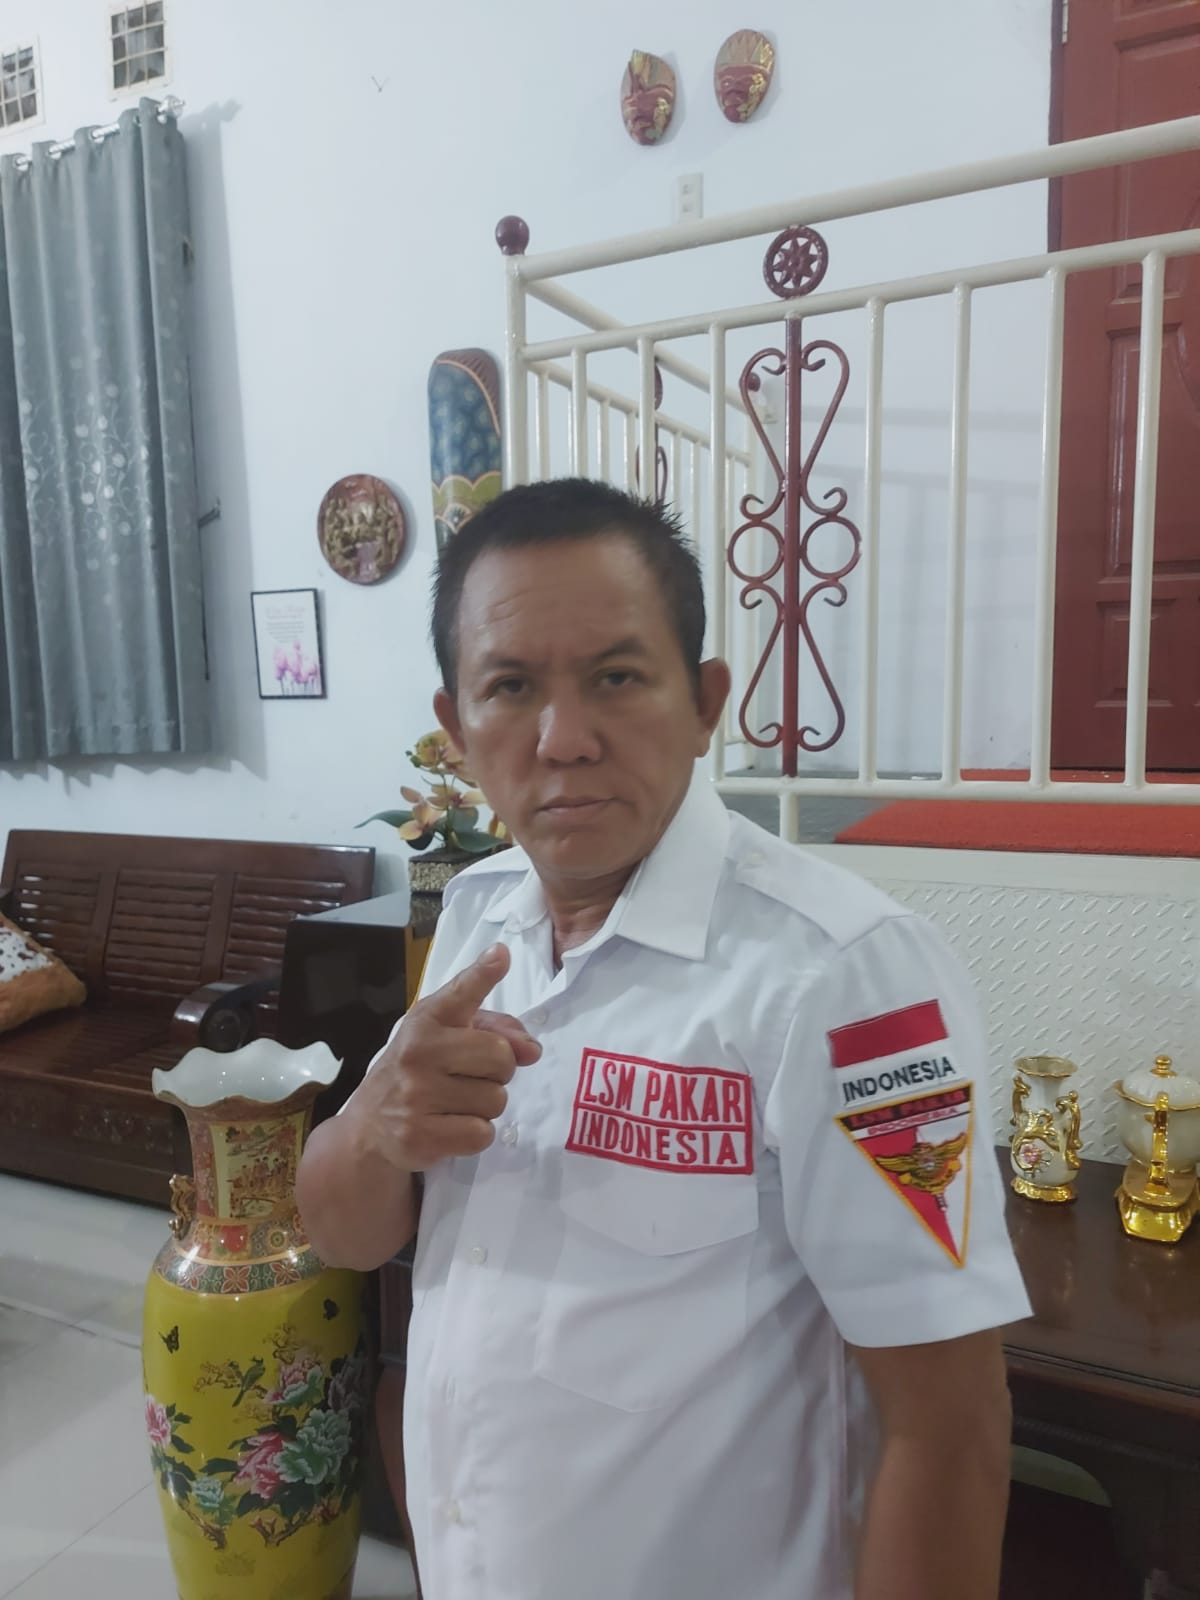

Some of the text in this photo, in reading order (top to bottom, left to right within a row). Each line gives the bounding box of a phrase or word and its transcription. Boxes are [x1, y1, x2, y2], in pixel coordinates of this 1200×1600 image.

[583, 1058, 743, 1123] LSM PAKAR
[842, 1056, 956, 1103] INDONESIA
[578, 1110, 738, 1165] INDONESIA
